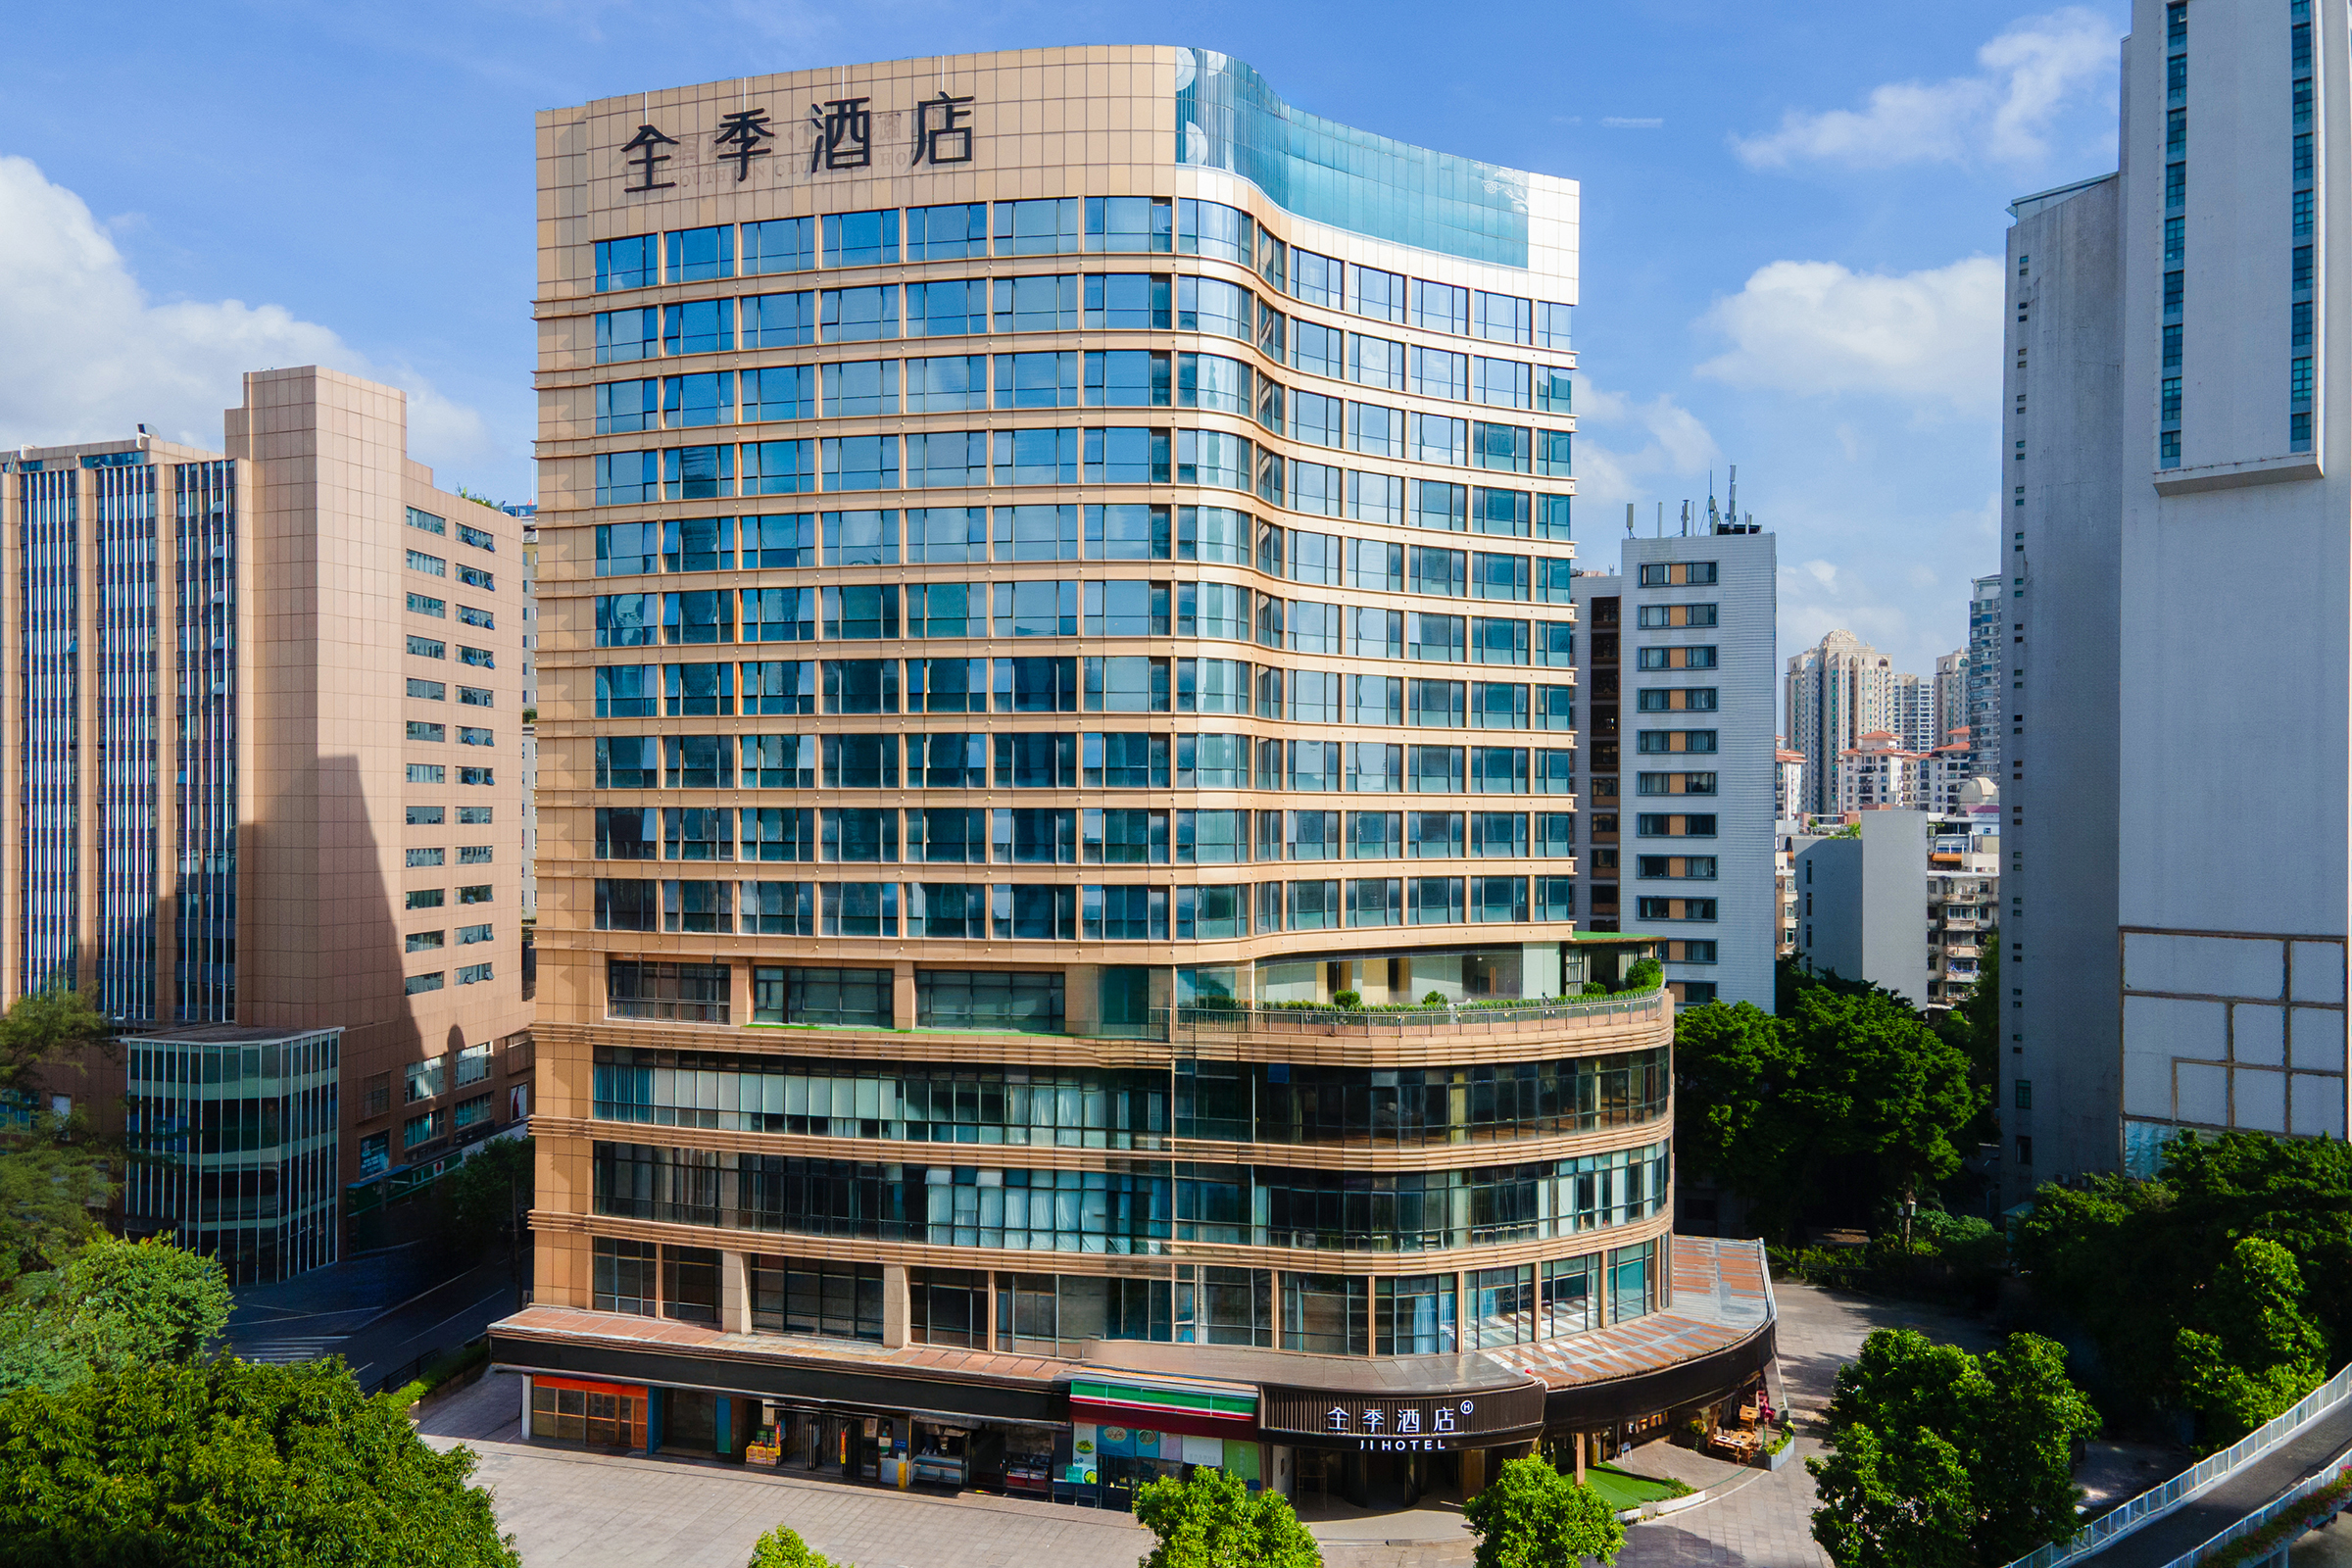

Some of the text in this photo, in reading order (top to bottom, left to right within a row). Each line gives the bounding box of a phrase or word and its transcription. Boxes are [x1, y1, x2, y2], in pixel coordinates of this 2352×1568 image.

[620, 91, 975, 193] 全季酒店
[1327, 1406, 1455, 1433] 全季酒店
[1360, 1440, 1446, 1450] JI HOTEL
